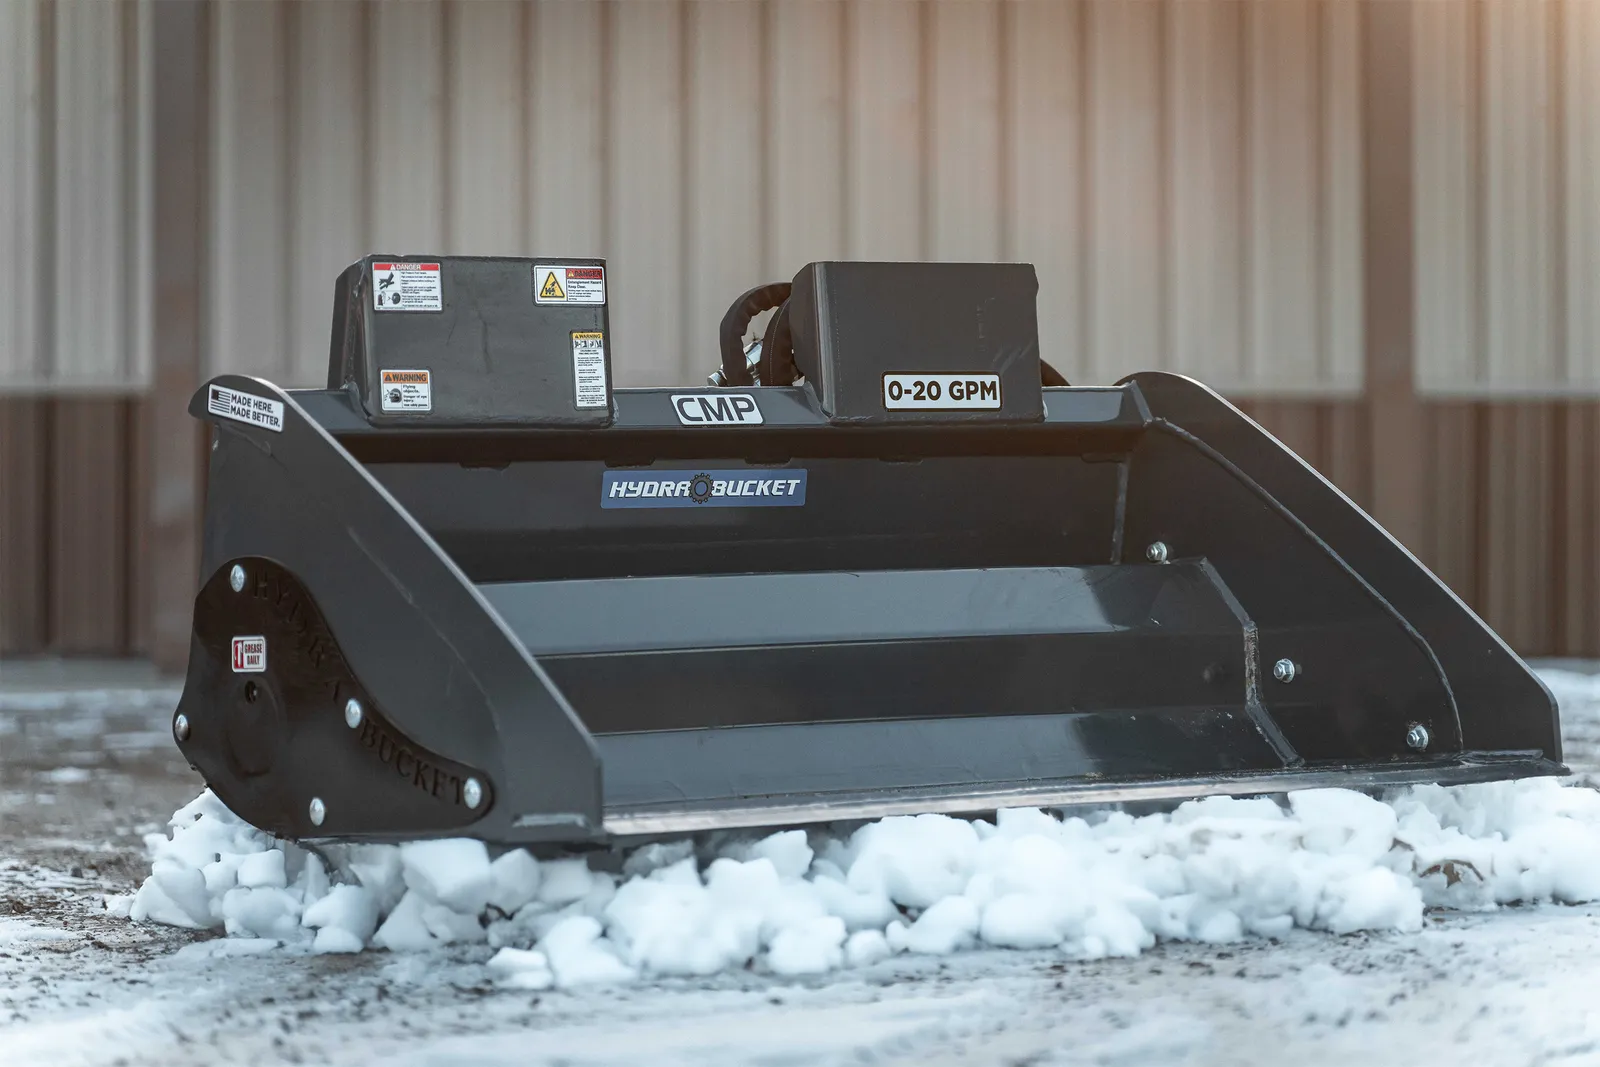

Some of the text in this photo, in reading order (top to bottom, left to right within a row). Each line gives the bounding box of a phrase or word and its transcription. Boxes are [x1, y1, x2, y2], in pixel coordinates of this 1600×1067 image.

[888, 380, 998, 401] 0-20 GPM
[231, 394, 273, 413] MADE HERE.
[676, 397, 755, 422] CMP
[230, 405, 280, 427] MADE BETTER.
[609, 479, 801, 498] HYDRA BUCKET
[244, 643, 262, 653] GREASE
[246, 654, 260, 665] DAILY
[361, 717, 464, 805] BUCKET
